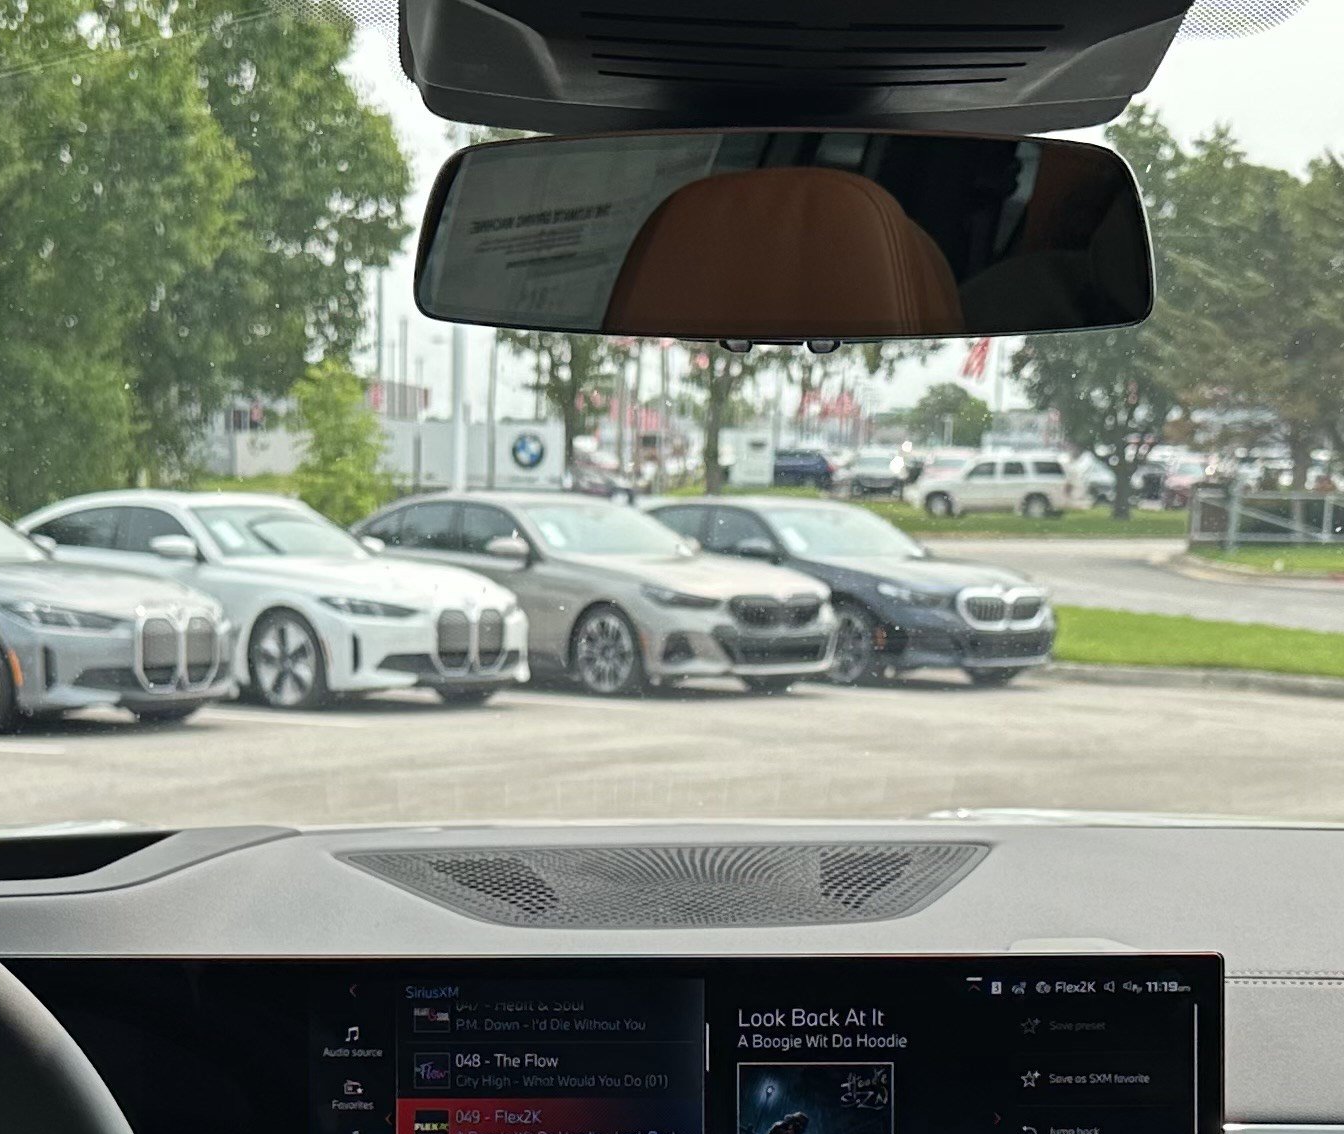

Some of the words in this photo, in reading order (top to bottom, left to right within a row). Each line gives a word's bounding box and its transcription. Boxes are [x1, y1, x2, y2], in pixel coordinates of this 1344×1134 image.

[406, 986, 459, 999] SiriusXM
[1056, 982, 1096, 993] Flex2K
[738, 1008, 786, 1027] Look
[792, 1008, 840, 1027] Back
[845, 1008, 867, 1027] At
[872, 1008, 885, 1027] It
[550, 1018, 570, 1031] Die
[574, 1018, 620, 1031] Without
[624, 1019, 646, 1031] You
[737, 1034, 749, 1048] A
[753, 1034, 802, 1051] Boogie
[806, 1034, 828, 1048] Wit
[832, 1034, 852, 1048] Da
[856, 1034, 908, 1048] Hoodie
[323, 1047, 349, 1058] Audio
[352, 1048, 383, 1058] source
[456, 1054, 481, 1068] 048
[494, 1053, 520, 1068] The
[524, 1053, 559, 1068] Flow
[456, 1074, 478, 1089] City
[482, 1074, 511, 1089] High
[523, 1074, 554, 1087] What
[558, 1074, 595, 1087] Would
[599, 1075, 621, 1087] You
[624, 1075, 642, 1087] Do
[645, 1074, 669, 1089] (01)
[1049, 1074, 1074, 1083] Save
[1089, 1074, 1112, 1083] SXM
[1114, 1073, 1150, 1083] favorite
[332, 1099, 374, 1110] Favorites
[456, 1109, 480, 1124] 049
[494, 1109, 542, 1124] Flex2K
